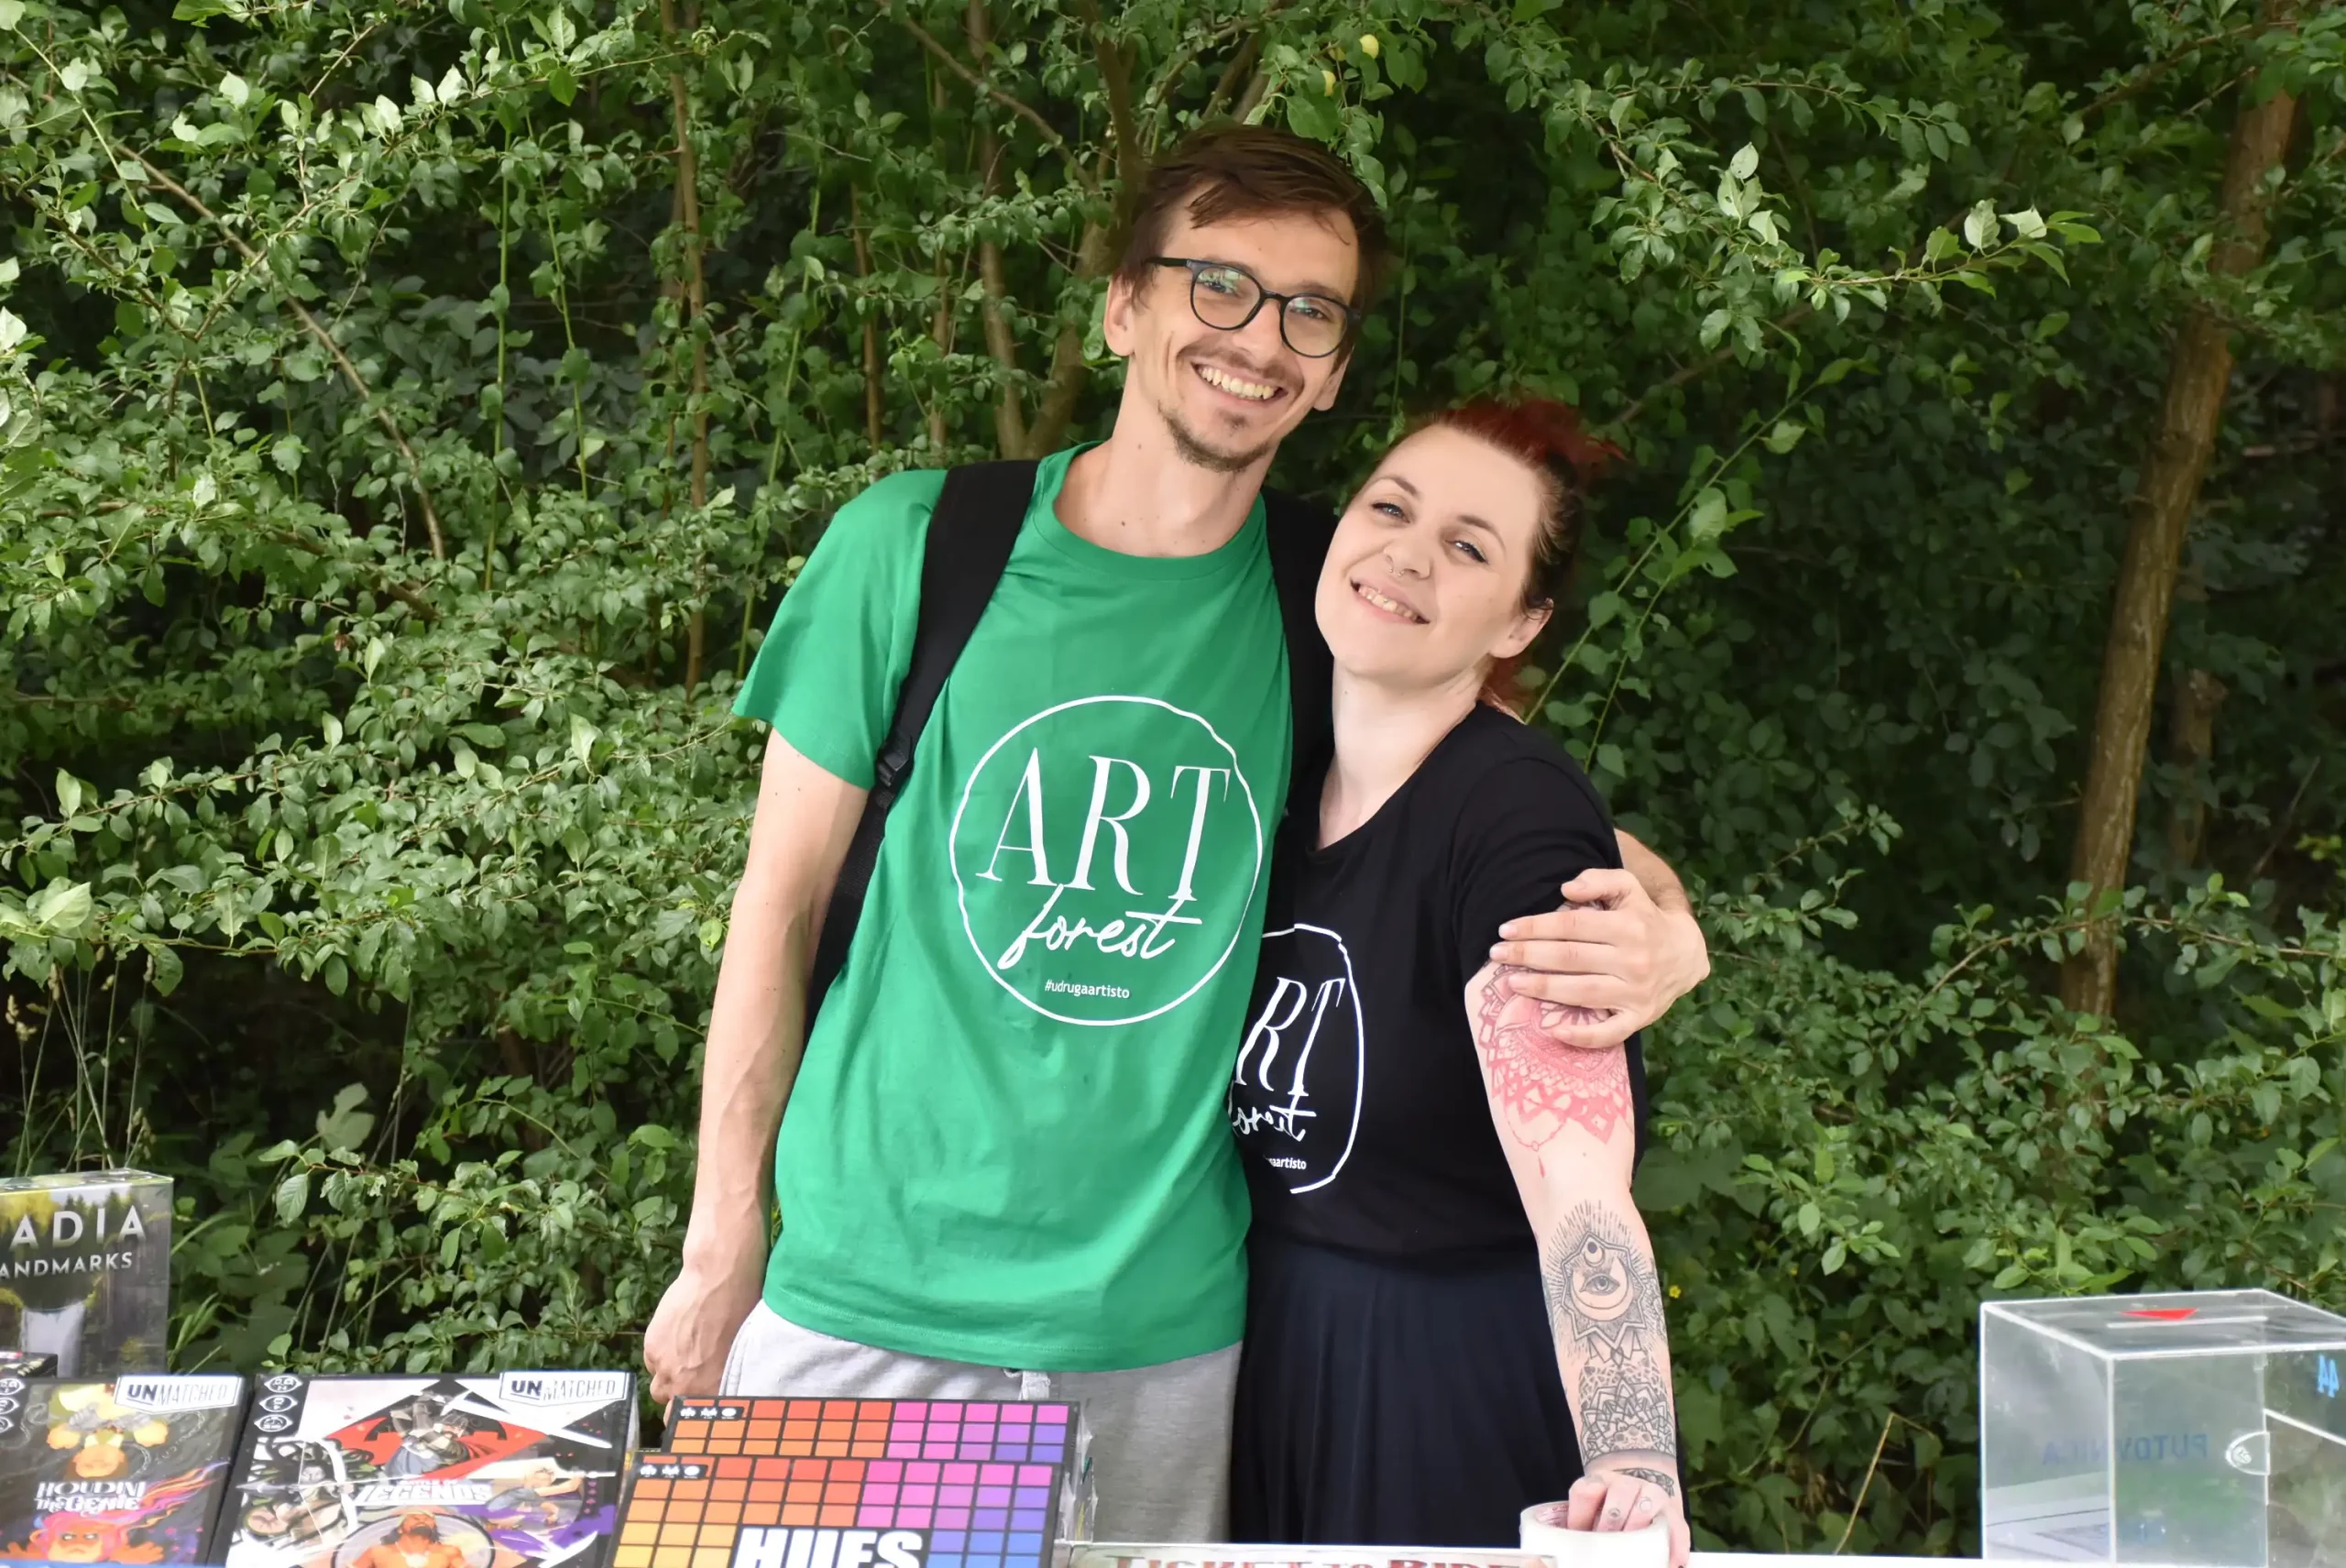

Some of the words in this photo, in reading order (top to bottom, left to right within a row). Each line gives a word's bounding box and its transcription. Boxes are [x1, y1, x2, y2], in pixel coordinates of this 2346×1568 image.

[976, 748, 1231, 902] ART
[997, 883, 1202, 970] forest
[1045, 979, 1130, 999] #udrugaartisto
[1266, 1157, 1307, 1170] aartisto
[8, 1205, 147, 1252] ADIA
[0, 1251, 133, 1279] ANDMARKS
[127, 1384, 227, 1405] UNMATCHED
[510, 1379, 616, 1400] UNMATCHED
[37, 1481, 147, 1497] HOUDINI
